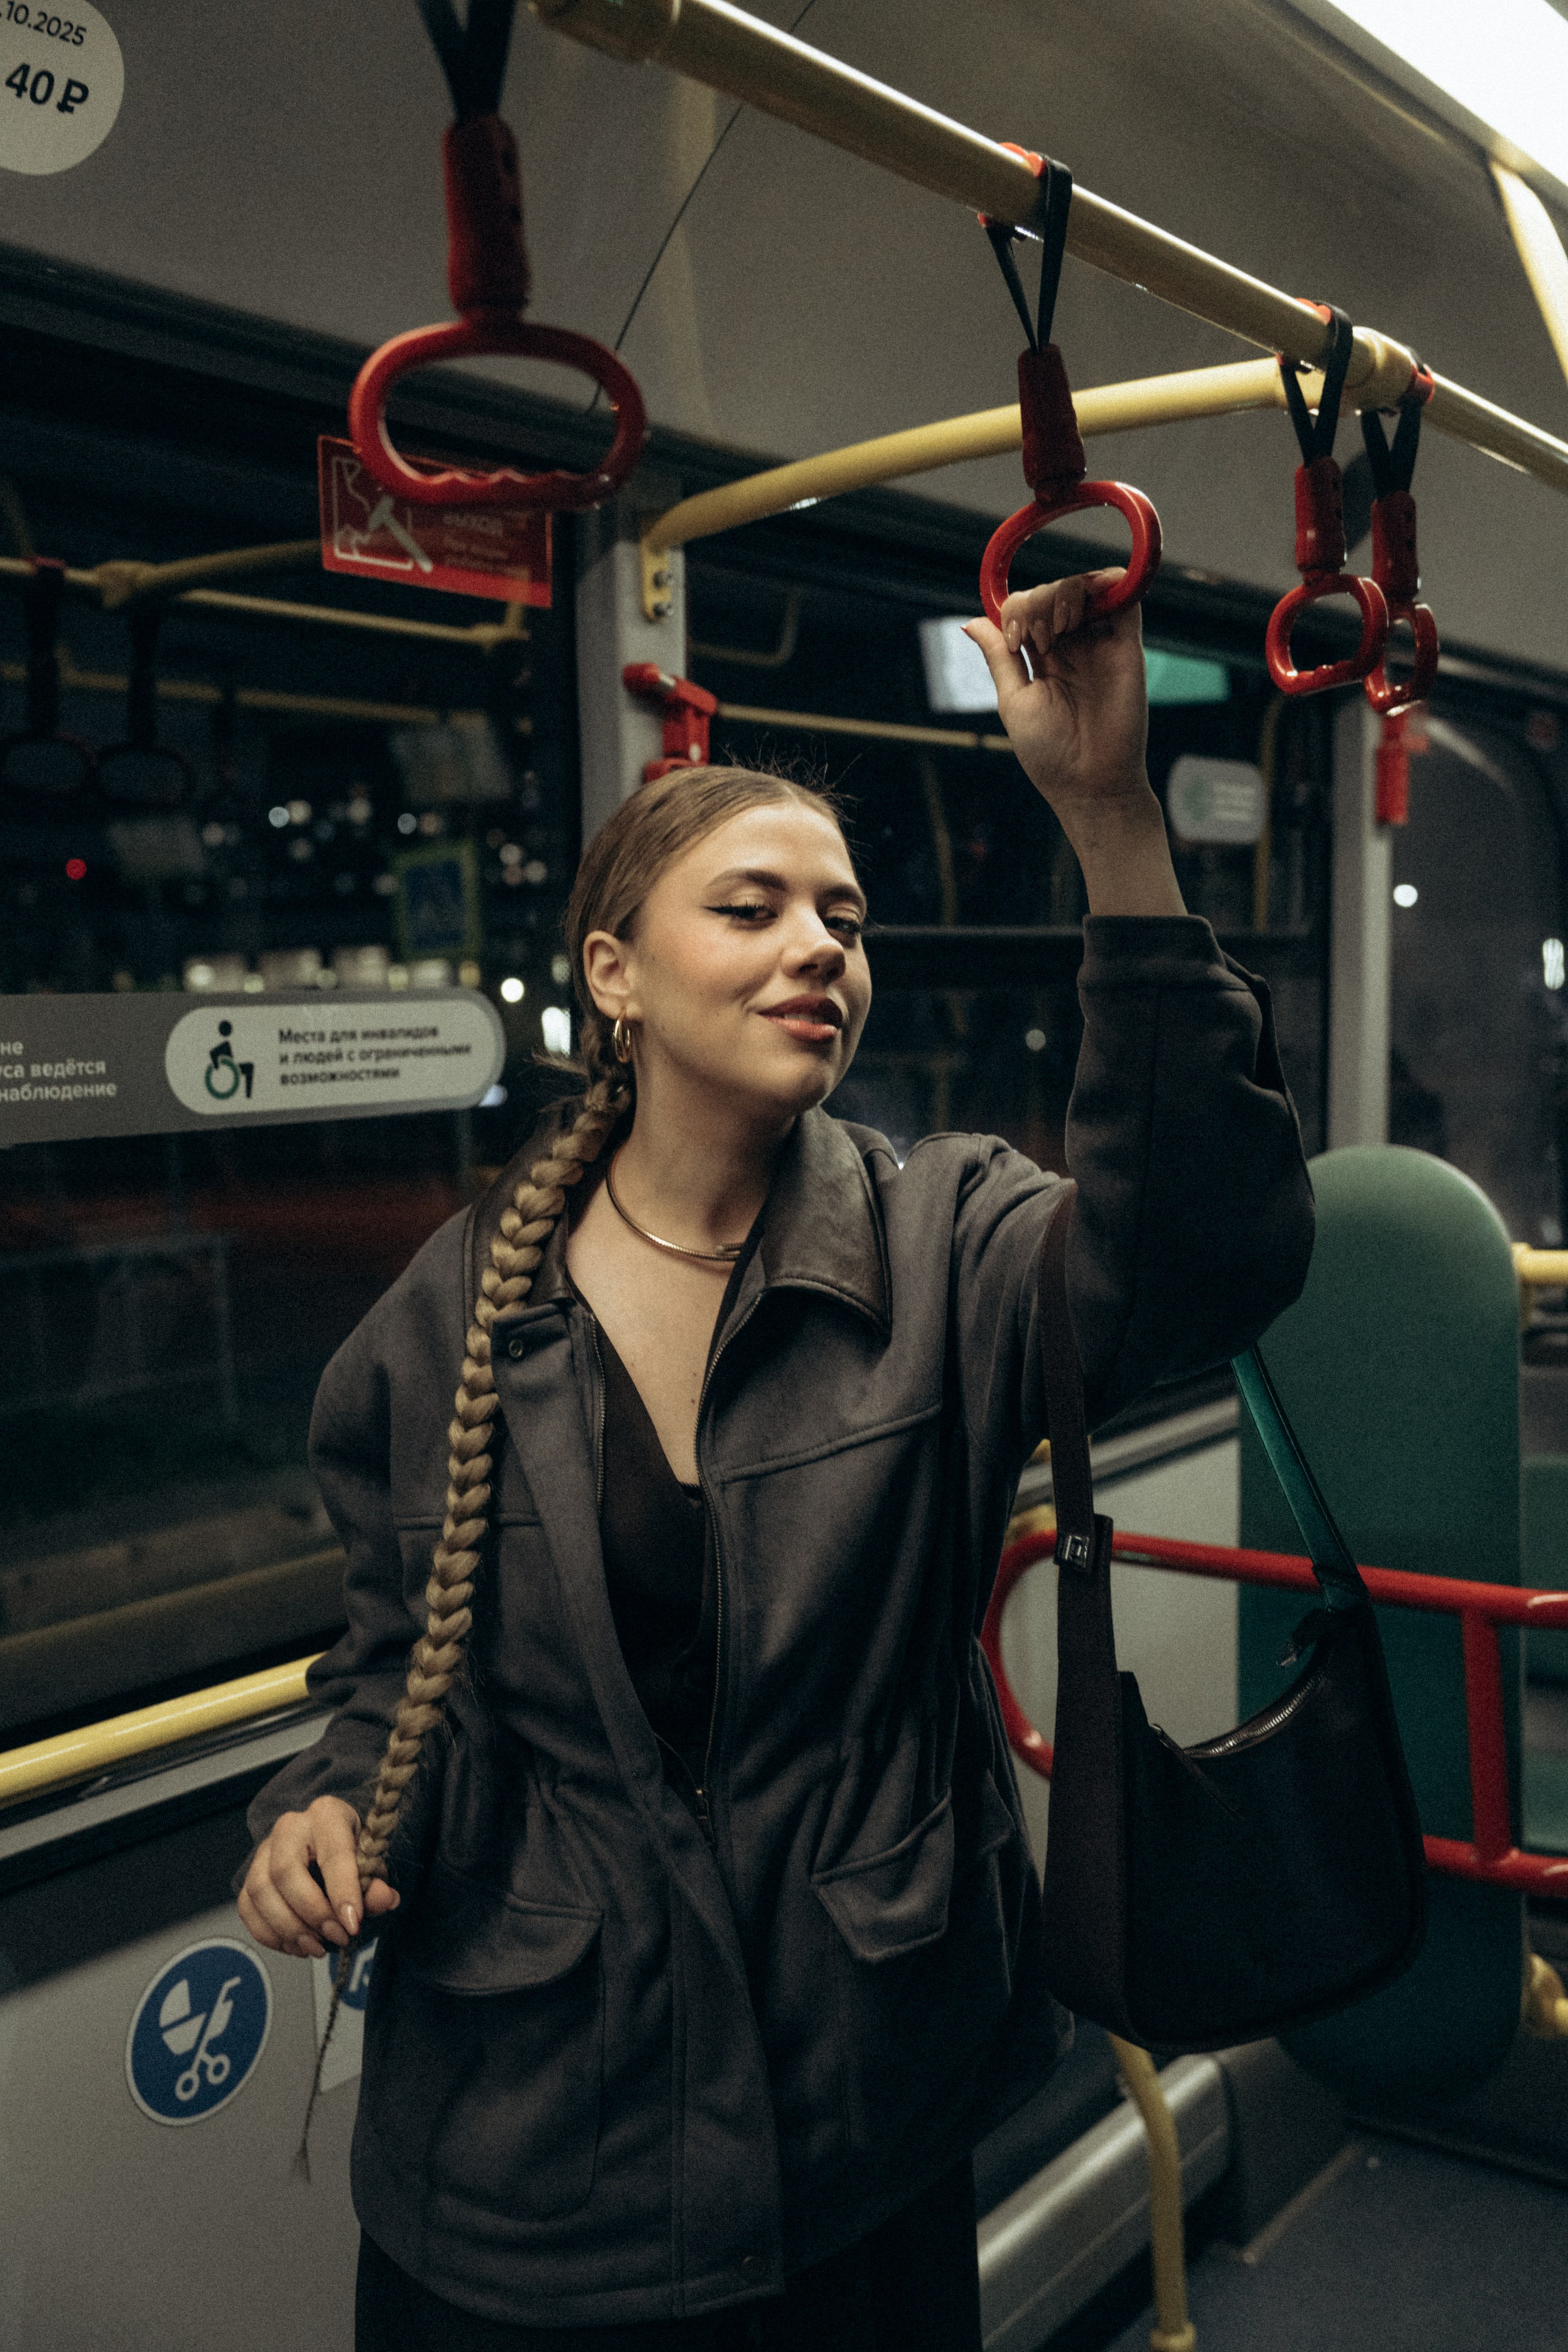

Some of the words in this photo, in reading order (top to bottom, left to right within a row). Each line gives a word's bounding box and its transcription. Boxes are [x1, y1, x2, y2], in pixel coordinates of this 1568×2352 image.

[279, 1028, 326, 1044] Места
[330, 1030, 358, 1044] для
[361, 1027, 439, 1040] инвалидов
[279, 1054, 289, 1065] и
[293, 1048, 344, 1066] людей
[346, 1049, 354, 1063] с
[31, 1058, 107, 1079] ведётся
[280, 1068, 400, 1086] возможностями
[0, 1083, 117, 1102] наблюдение
